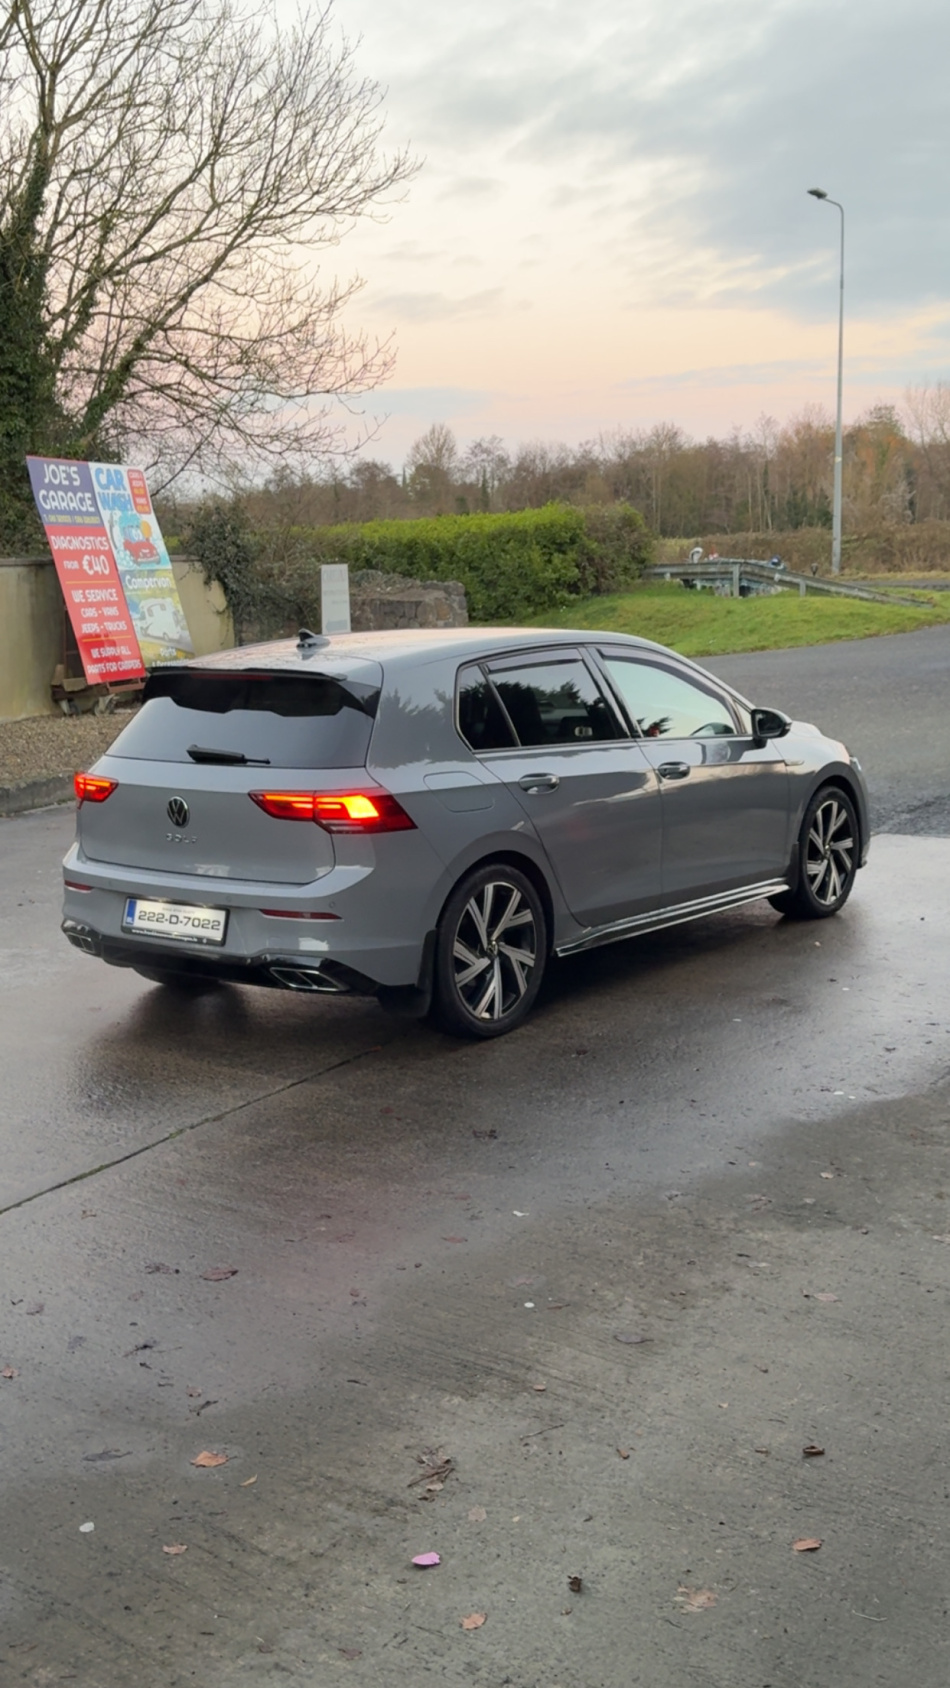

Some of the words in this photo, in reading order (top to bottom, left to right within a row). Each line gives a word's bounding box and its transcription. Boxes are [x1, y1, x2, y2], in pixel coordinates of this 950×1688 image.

[43, 463, 81, 486] JOE'S
[95, 467, 127, 491] CAR
[38, 489, 95, 512] GARAGE
[97, 491, 133, 512] WASH
[50, 535, 110, 551] DIAGNOSTICS
[63, 560, 79, 570] FROM
[82, 554, 110, 575] €40
[71, 589, 85, 604] WE
[85, 588, 119, 602] SERVICE
[81, 607, 98, 618] CARS
[102, 606, 119, 617] VANS
[81, 622, 100, 634] JEEPS
[104, 621, 127, 631] TRUCKS
[90, 647, 100, 659] WE
[100, 646, 119, 658] SUPPLY
[120, 645, 131, 655] ALL
[86, 663, 106, 674] PARTS
[106, 662, 118, 672] FOR
[117, 659, 142, 671] CAMPERS
[138, 910, 221, 931] 222-D-7022
